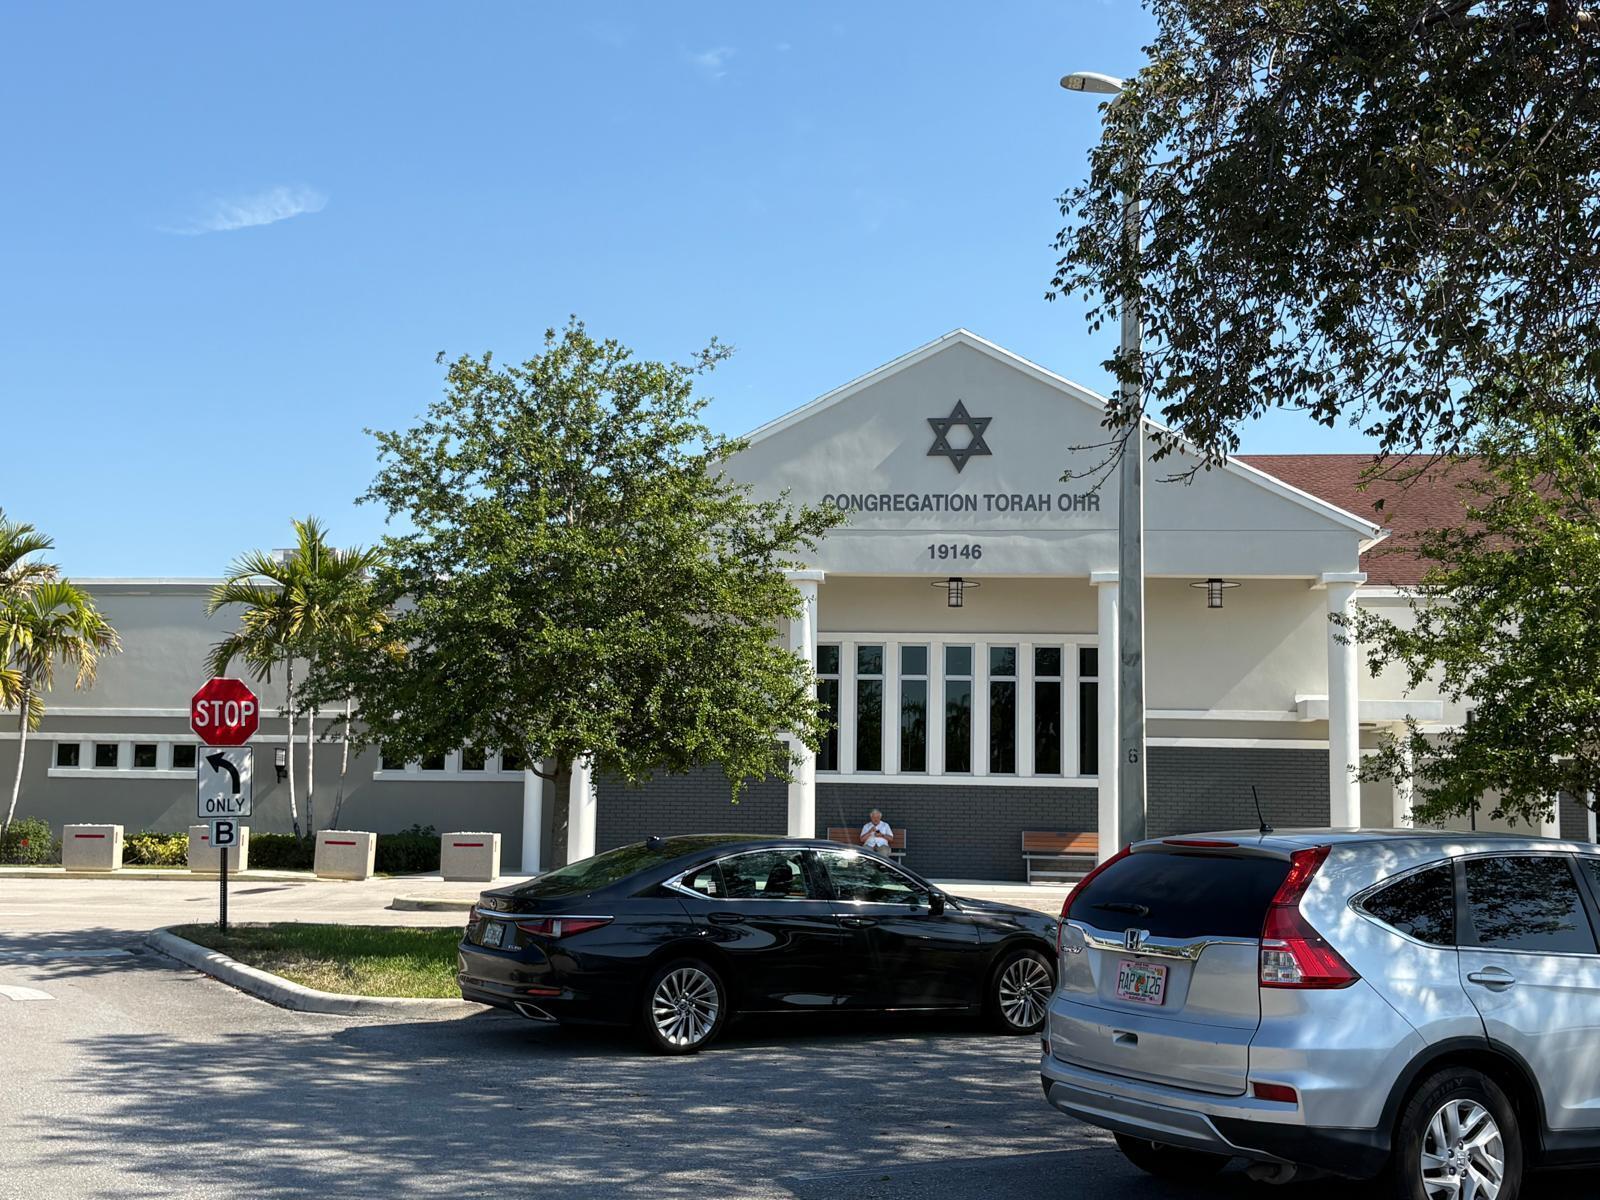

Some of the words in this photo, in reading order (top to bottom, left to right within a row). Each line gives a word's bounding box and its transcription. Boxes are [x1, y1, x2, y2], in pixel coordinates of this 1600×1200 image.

[983, 493, 1051, 512] TORAH
[1057, 493, 1100, 512] OHR
[927, 544, 982, 560] 19146
[195, 700, 255, 728] STOP
[1128, 748, 1138, 764] 6
[206, 798, 245, 813] ONLY
[215, 821, 234, 845] B
